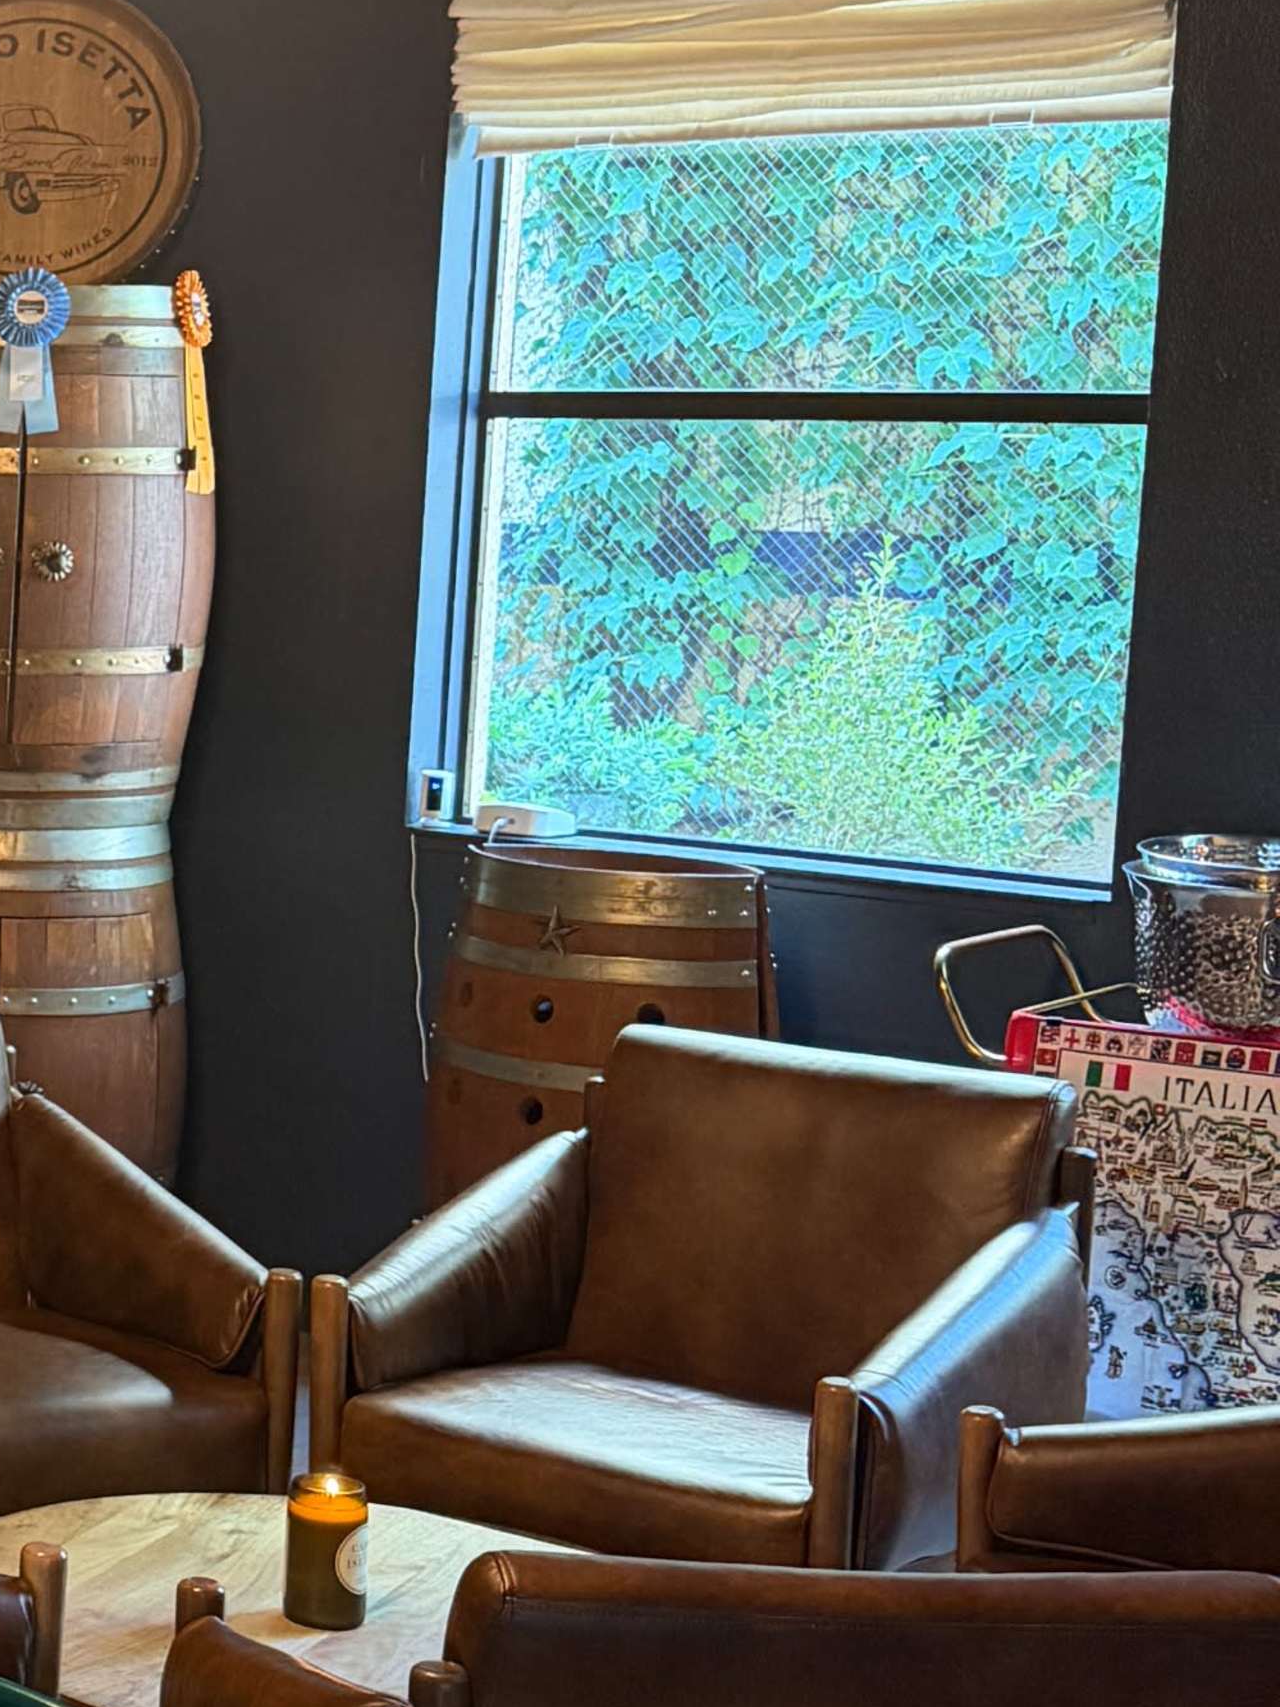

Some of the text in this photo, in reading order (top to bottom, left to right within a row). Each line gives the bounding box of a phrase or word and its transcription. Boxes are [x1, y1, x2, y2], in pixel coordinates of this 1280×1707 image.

[36, 29, 153, 131] ISETTA
[61, 226, 114, 260] WINES
[1162, 1076, 1278, 1115] ITALIA
